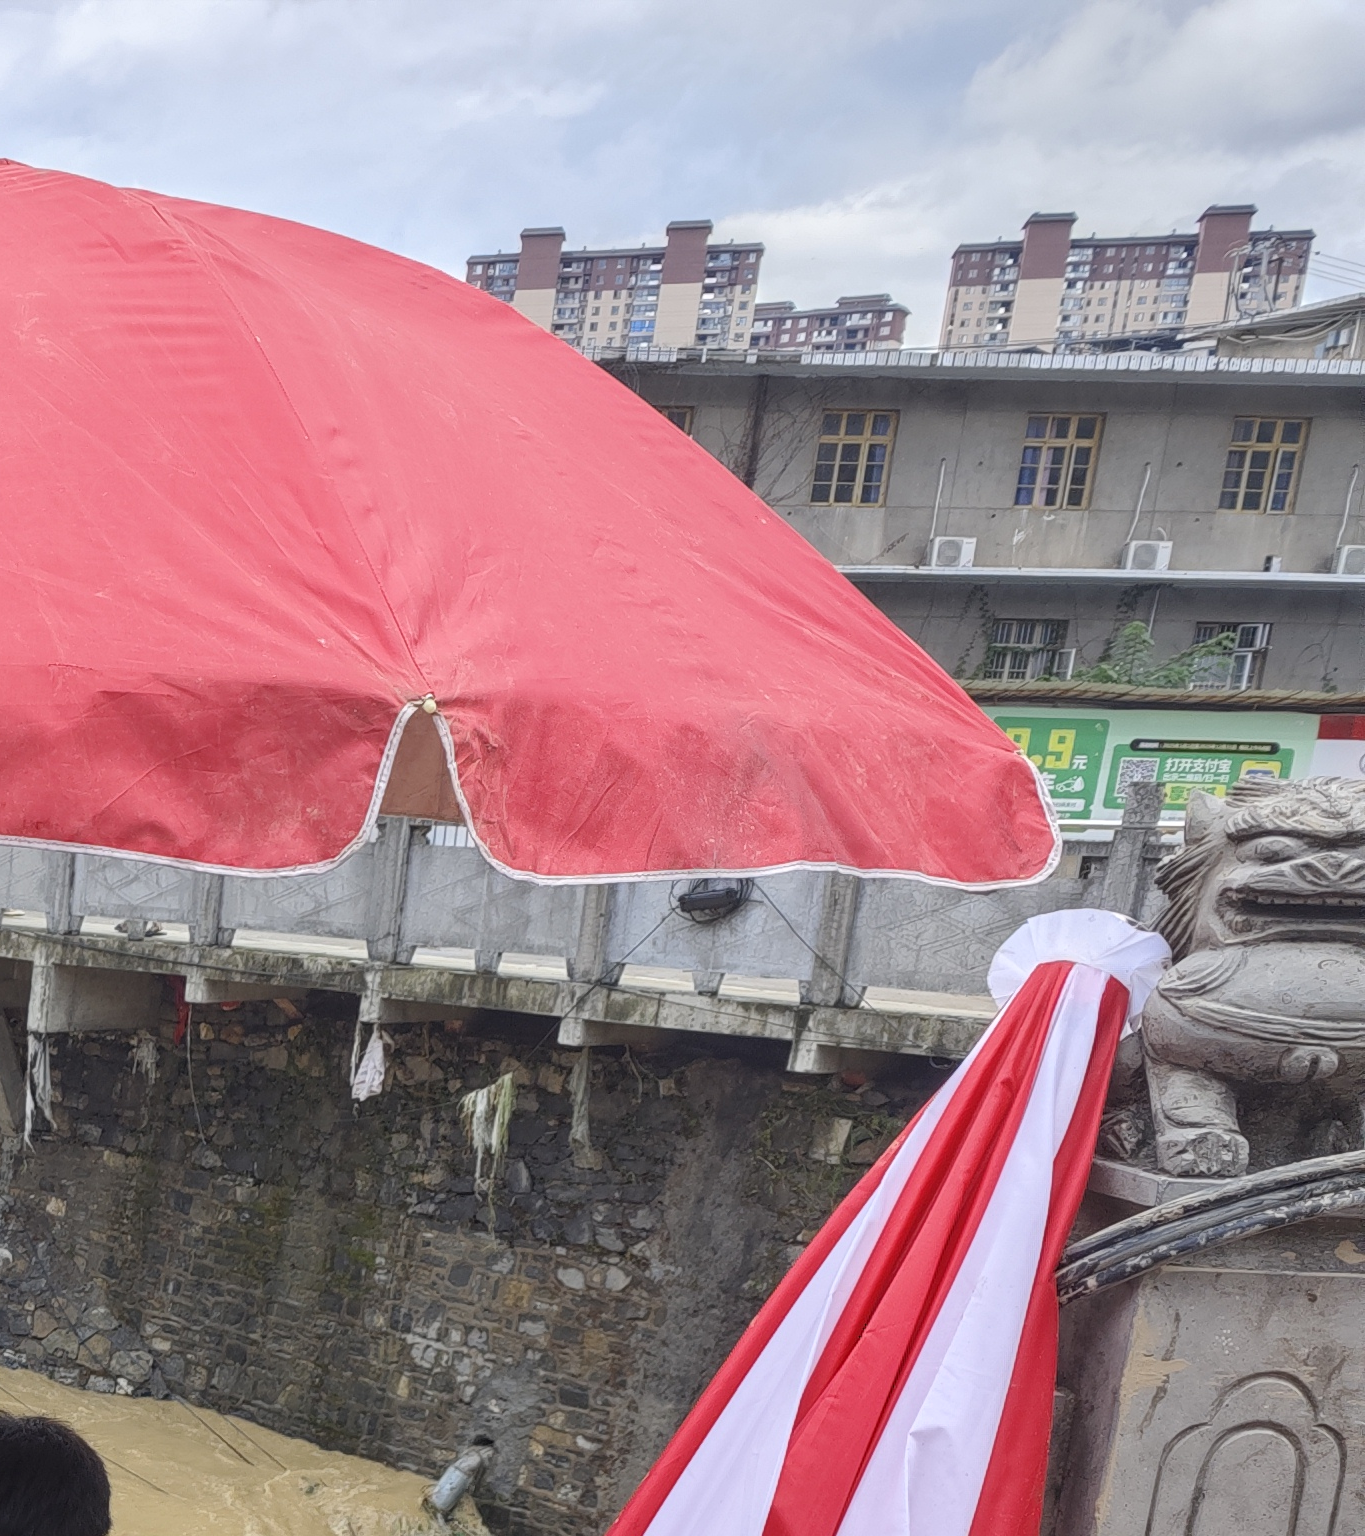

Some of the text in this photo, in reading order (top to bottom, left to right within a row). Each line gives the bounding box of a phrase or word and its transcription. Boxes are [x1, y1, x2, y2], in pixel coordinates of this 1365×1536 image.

[1164, 757, 1233, 773] 打开支付宝
